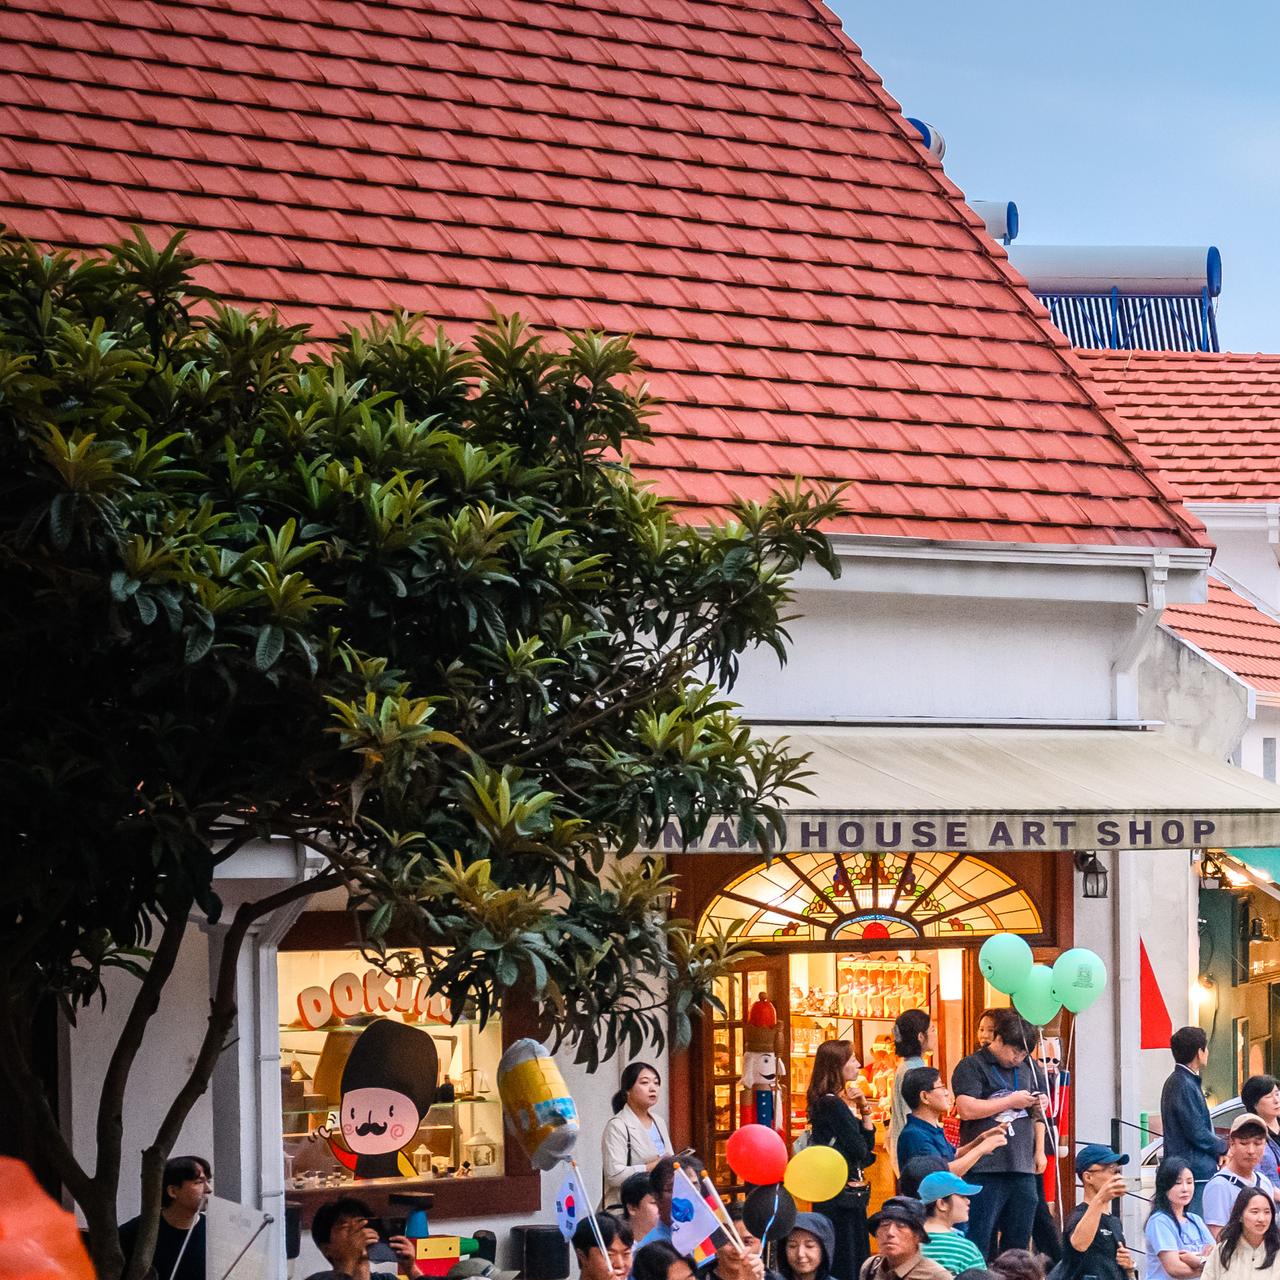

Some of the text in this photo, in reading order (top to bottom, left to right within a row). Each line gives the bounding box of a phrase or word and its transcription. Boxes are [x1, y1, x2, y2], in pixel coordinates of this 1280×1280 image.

[801, 821, 967, 848] HOUSE
[988, 820, 1077, 847] ART
[1097, 818, 1216, 847] SHOP
